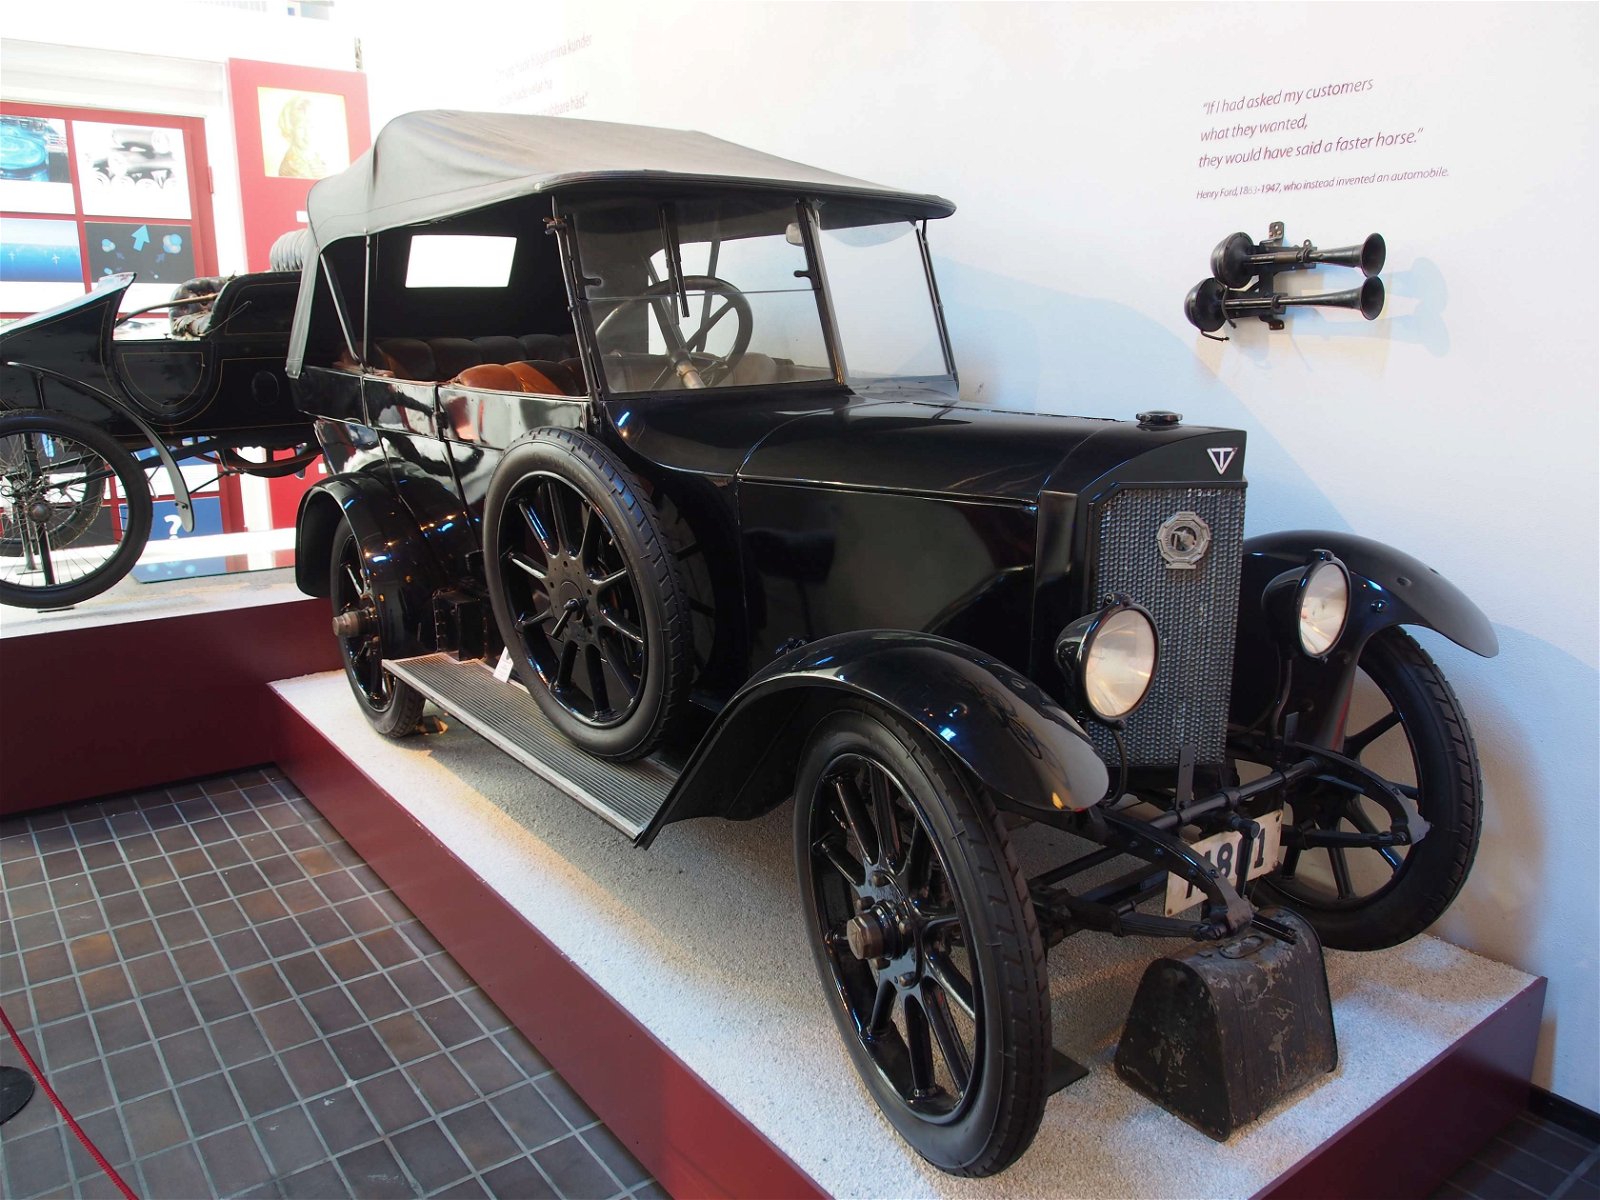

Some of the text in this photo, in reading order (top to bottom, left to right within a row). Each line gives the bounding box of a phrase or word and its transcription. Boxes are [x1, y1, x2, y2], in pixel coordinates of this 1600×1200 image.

[1222, 96, 1246, 112] had
[1247, 89, 1283, 109] asked
[1284, 90, 1304, 105] my
[1305, 79, 1374, 100] customers
[1201, 113, 1308, 142] what they wanted,
[1199, 154, 1223, 169] they
[1225, 147, 1262, 164] would
[1263, 146, 1294, 160] have
[1296, 141, 1323, 157] said
[1324, 142, 1334, 153] a
[1335, 136, 1374, 152] faster
[1196, 189, 1219, 200] Henry
[1220, 186, 1239, 197] Ford,
[1283, 179, 1302, 192] who
[1303, 176, 1335, 190] instead
[1336, 173, 1376, 187] invented
[1377, 173, 1390, 183] an
[1391, 165, 1449, 182] automobile.
